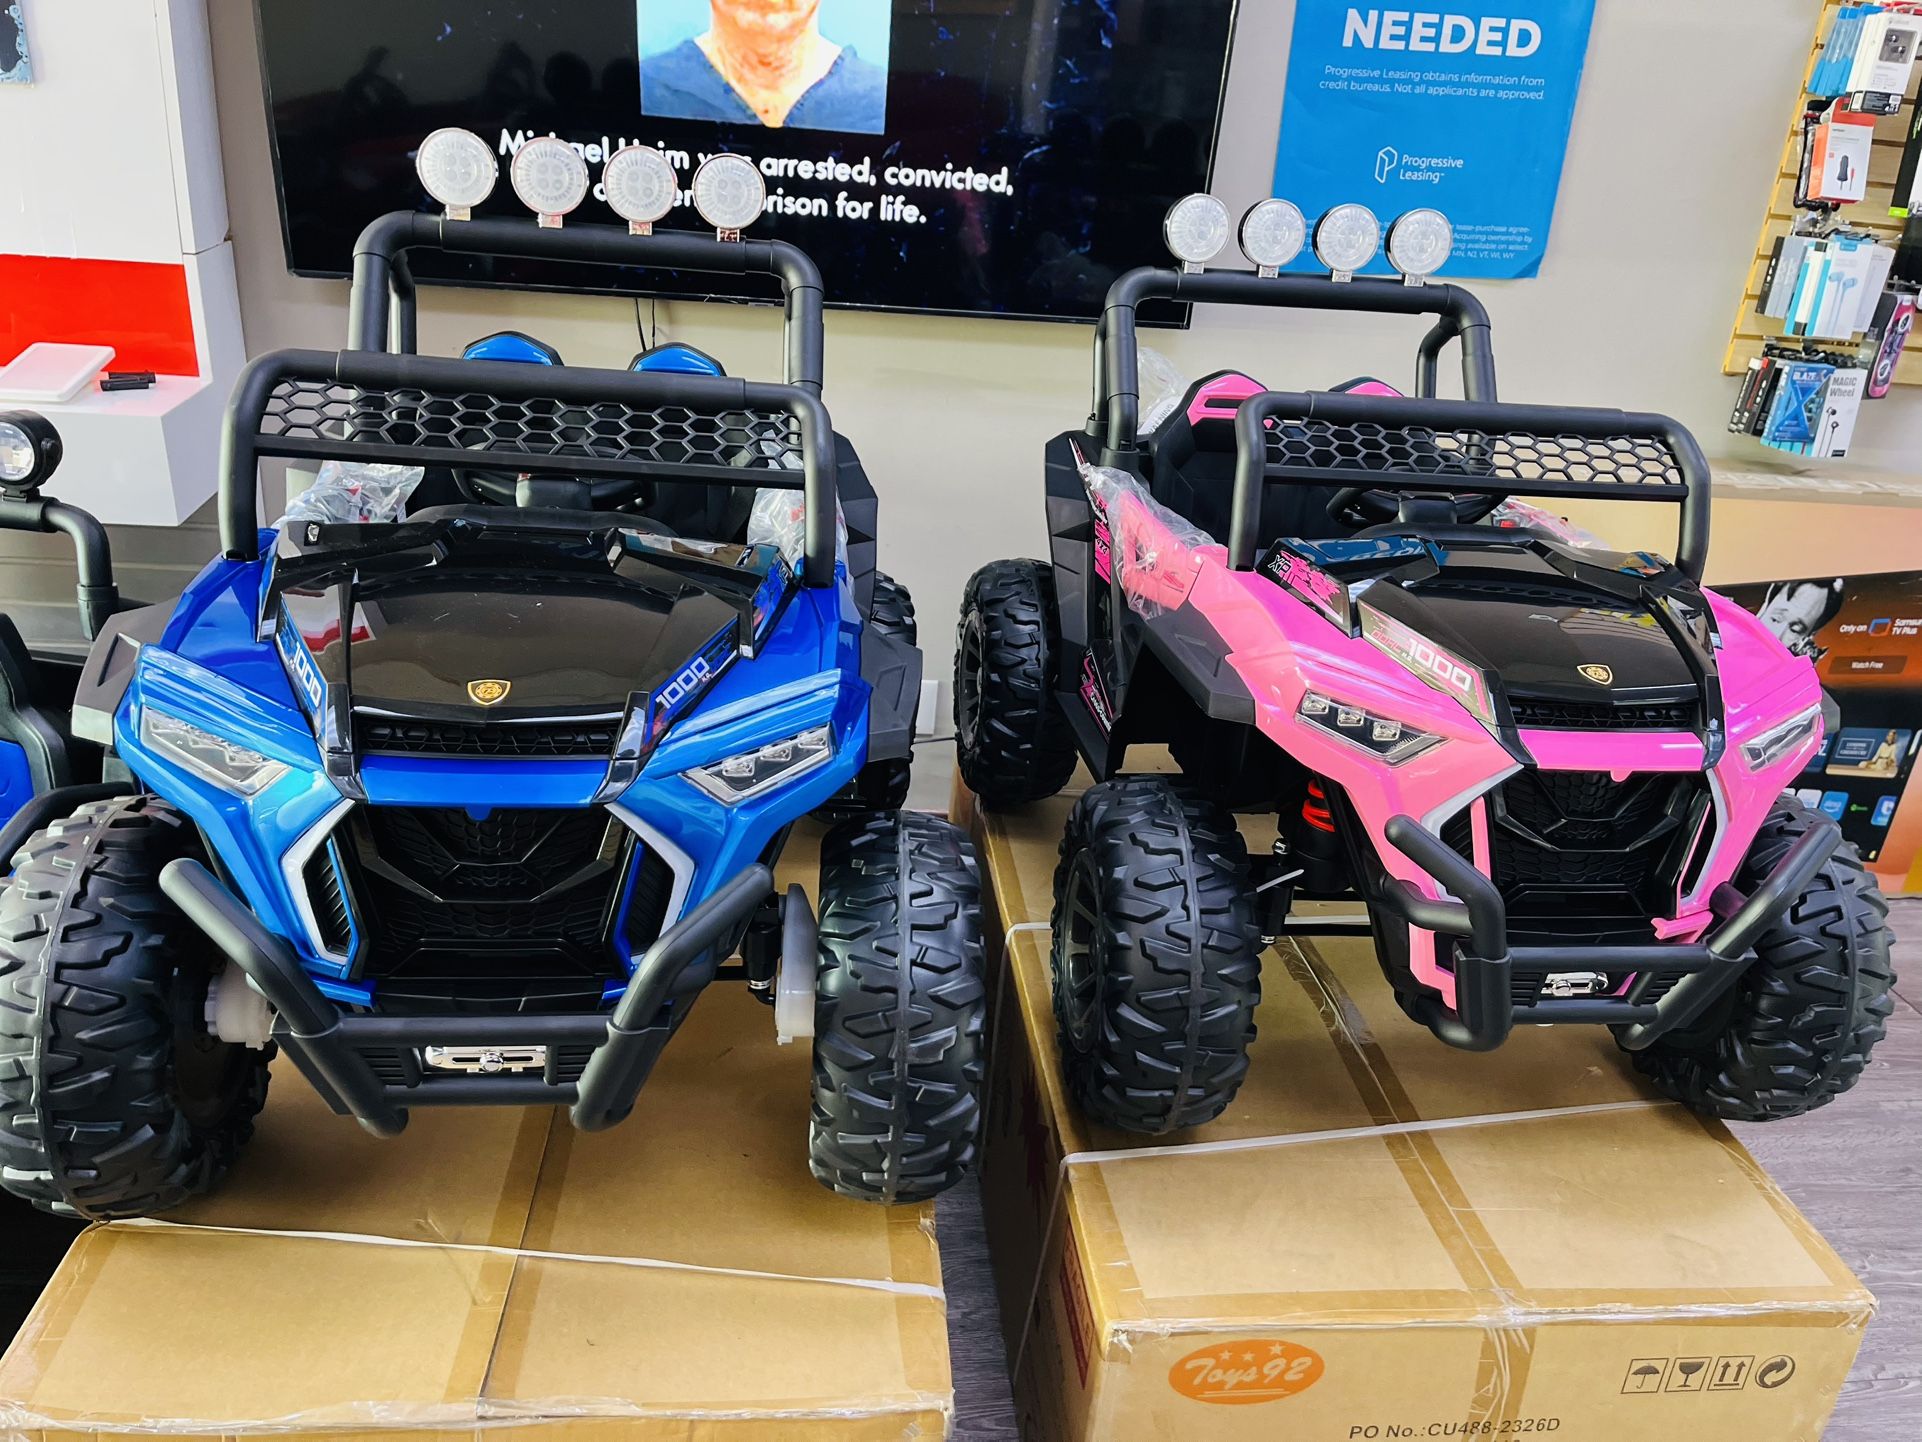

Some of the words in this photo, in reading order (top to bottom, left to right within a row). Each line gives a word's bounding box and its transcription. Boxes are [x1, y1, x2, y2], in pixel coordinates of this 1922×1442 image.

[1342, 8, 1542, 58] NEEDED
[1325, 65, 1380, 78] Progressive
[1383, 69, 1420, 82] Leasing
[1423, 71, 1459, 82] obtains
[1461, 73, 1518, 85] information
[1520, 75, 1545, 86] from
[1320, 80, 1348, 90] credit
[1350, 81, 1392, 92] bureaus.
[1394, 83, 1412, 93] Not
[1414, 84, 1426, 94] all
[1427, 85, 1477, 96] applicants
[1480, 89, 1495, 97] are
[1497, 90, 1544, 100] approved.
[1402, 154, 1464, 169] Progressive
[760, 157, 876, 186] arrested,
[885, 166, 1014, 197] convicted,
[836, 193, 870, 221] for
[880, 195, 927, 224] life.
[1524, 235, 1533, 243] by
[1832, 376, 1858, 387] MAGIC
[1830, 387, 1855, 397] Wheel
[1840, 624, 1856, 633] Only
[1856, 624, 1867, 632] on
[1892, 627, 1902, 635] TV
[1902, 626, 1918, 635] Plus
[294, 641, 322, 707] 1000
[1408, 637, 1473, 691] 1000
[655, 656, 710, 709] 1000
[1349, 1425, 1379, 1439] PO
